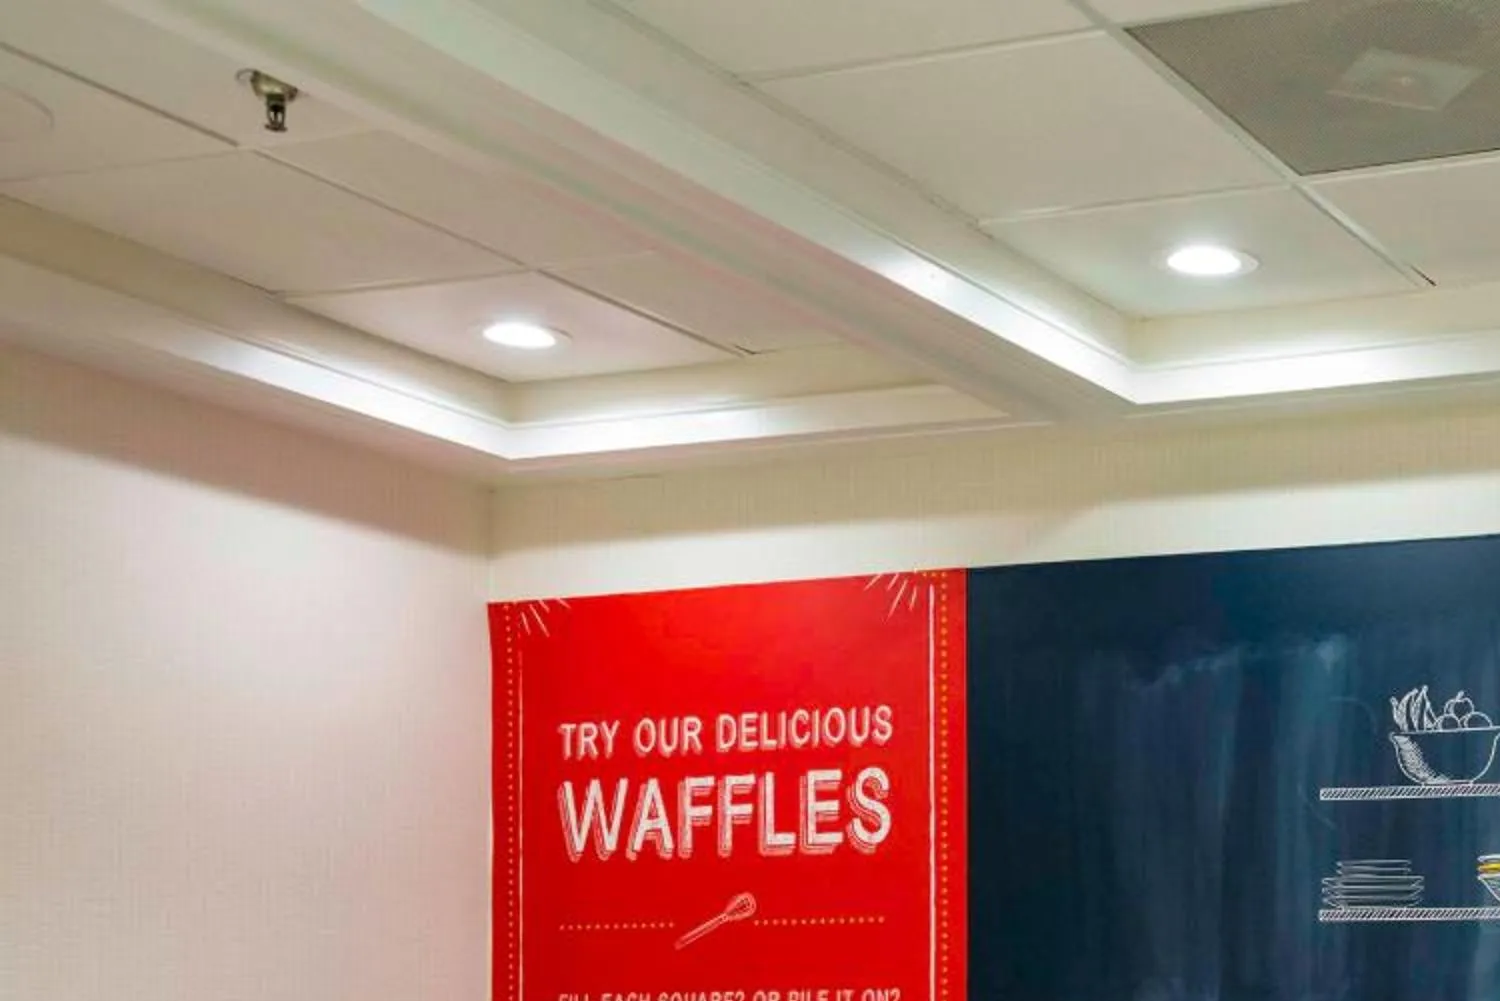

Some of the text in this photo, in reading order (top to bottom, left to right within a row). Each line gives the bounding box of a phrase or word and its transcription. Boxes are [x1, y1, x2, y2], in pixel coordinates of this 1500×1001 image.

[558, 704, 893, 760] TRY OUR DELICIOUS
[557, 766, 892, 862] WAFFLES
